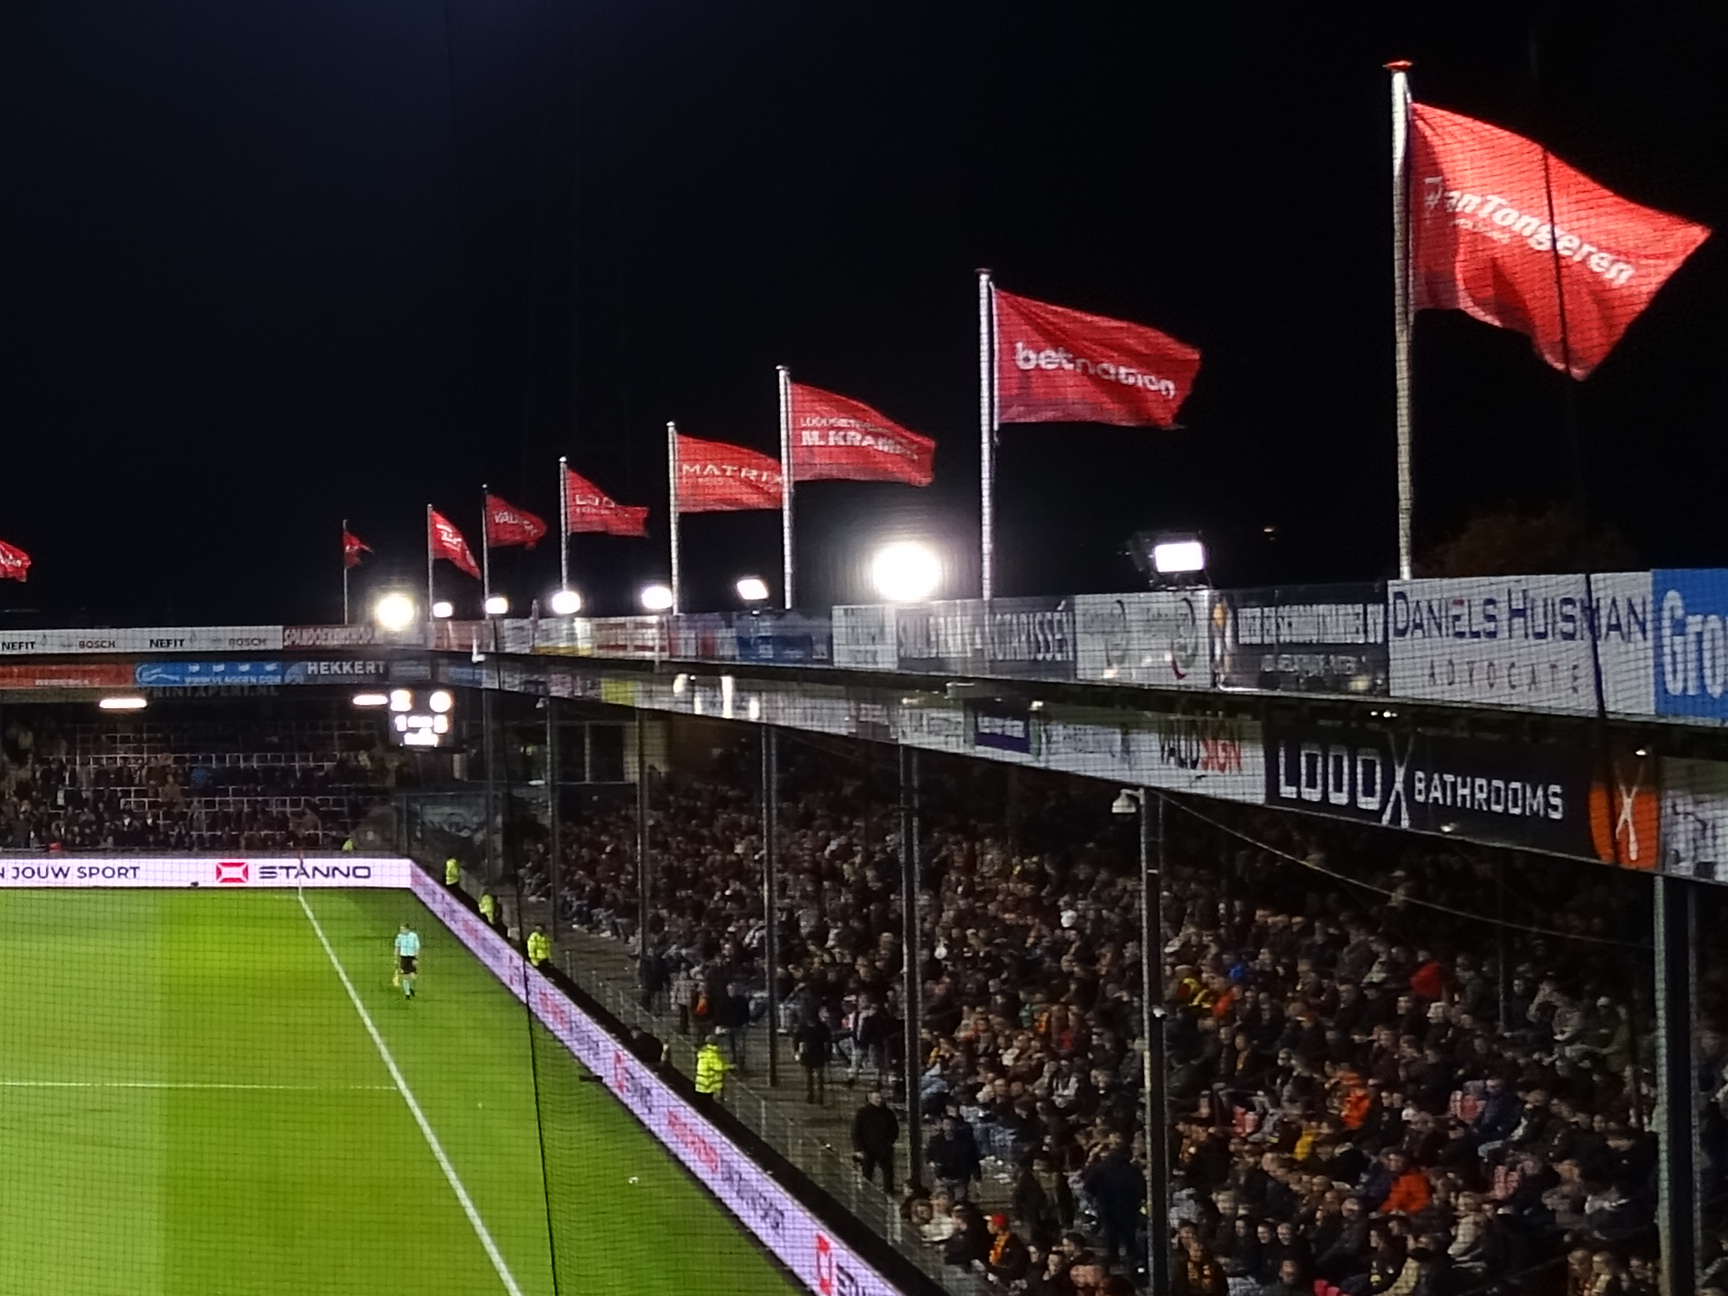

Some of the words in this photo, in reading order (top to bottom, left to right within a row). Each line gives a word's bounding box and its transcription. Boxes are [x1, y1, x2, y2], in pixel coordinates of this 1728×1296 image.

[1391, 589, 1498, 640] DANIELS
[1506, 586, 1650, 644] HUISMAN
[1, 640, 36, 652] NEFIT
[78, 639, 116, 650] BOSCH
[149, 638, 185, 649] NEFIT
[228, 637, 267, 647] BOSCH
[1660, 589, 1728, 698] Gro
[307, 659, 386, 676] HEKKERT
[1429, 659, 1581, 695] ADVOCATE
[1413, 770, 1565, 821] BATHROOMS
[10, 866, 71, 880] JOUW
[76, 865, 141, 880] SPORT
[258, 865, 372, 879] STANNO
